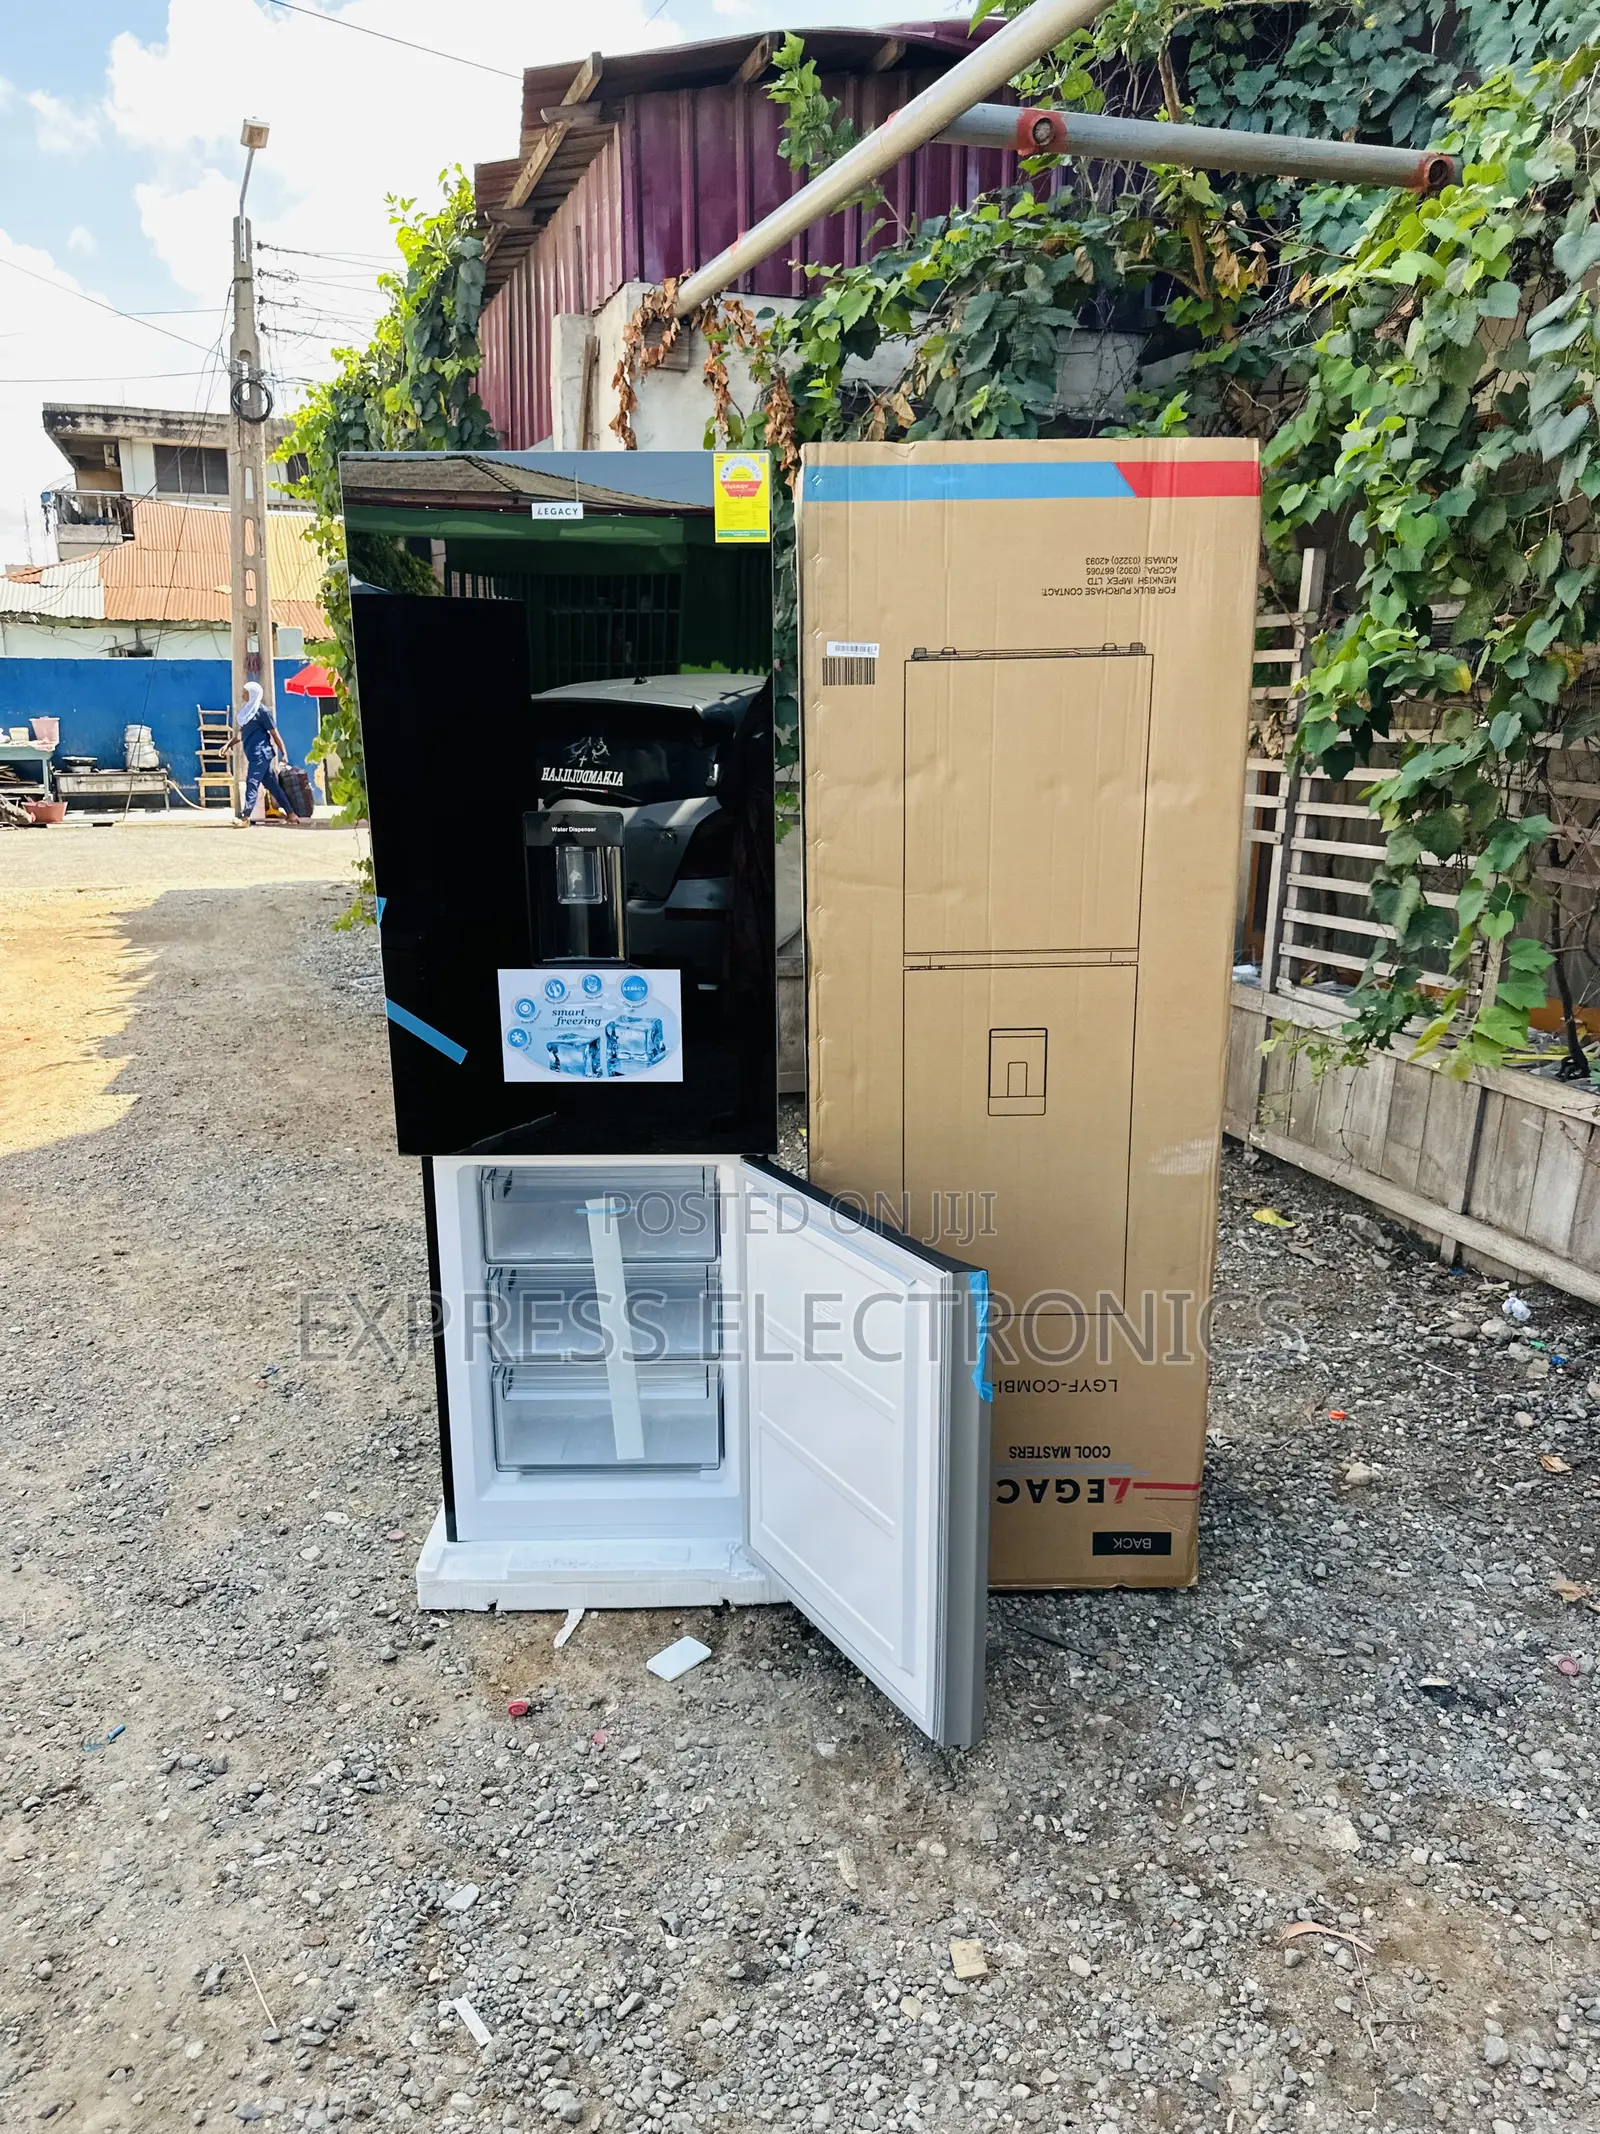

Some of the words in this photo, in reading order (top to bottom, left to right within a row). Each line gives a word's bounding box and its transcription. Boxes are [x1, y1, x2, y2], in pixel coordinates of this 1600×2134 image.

[537, 507, 578, 516] LEGACY
[1085, 557, 1110, 565] 42093
[1111, 556, 1140, 566] (03220)
[1086, 567, 1115, 575] 667065
[1116, 566, 1141, 575] (0302)
[1087, 577, 1103, 586] LTD
[1107, 577, 1133, 585] IMPEX
[1138, 576, 1177, 584] MENKISH
[1084, 587, 1132, 595] PURCHASE
[1133, 586, 1156, 595] BULK
[1158, 586, 1176, 594] FOR
[569, 826, 597, 834] Dispenser
[552, 1009, 585, 1017] smart
[554, 1016, 601, 1028] freezing
[1009, 1445, 1071, 1459] MASTERS
[1075, 1445, 1111, 1458] COOL
[989, 1477, 1132, 1505] LEGAC
[1113, 1537, 1152, 1549] BACK
